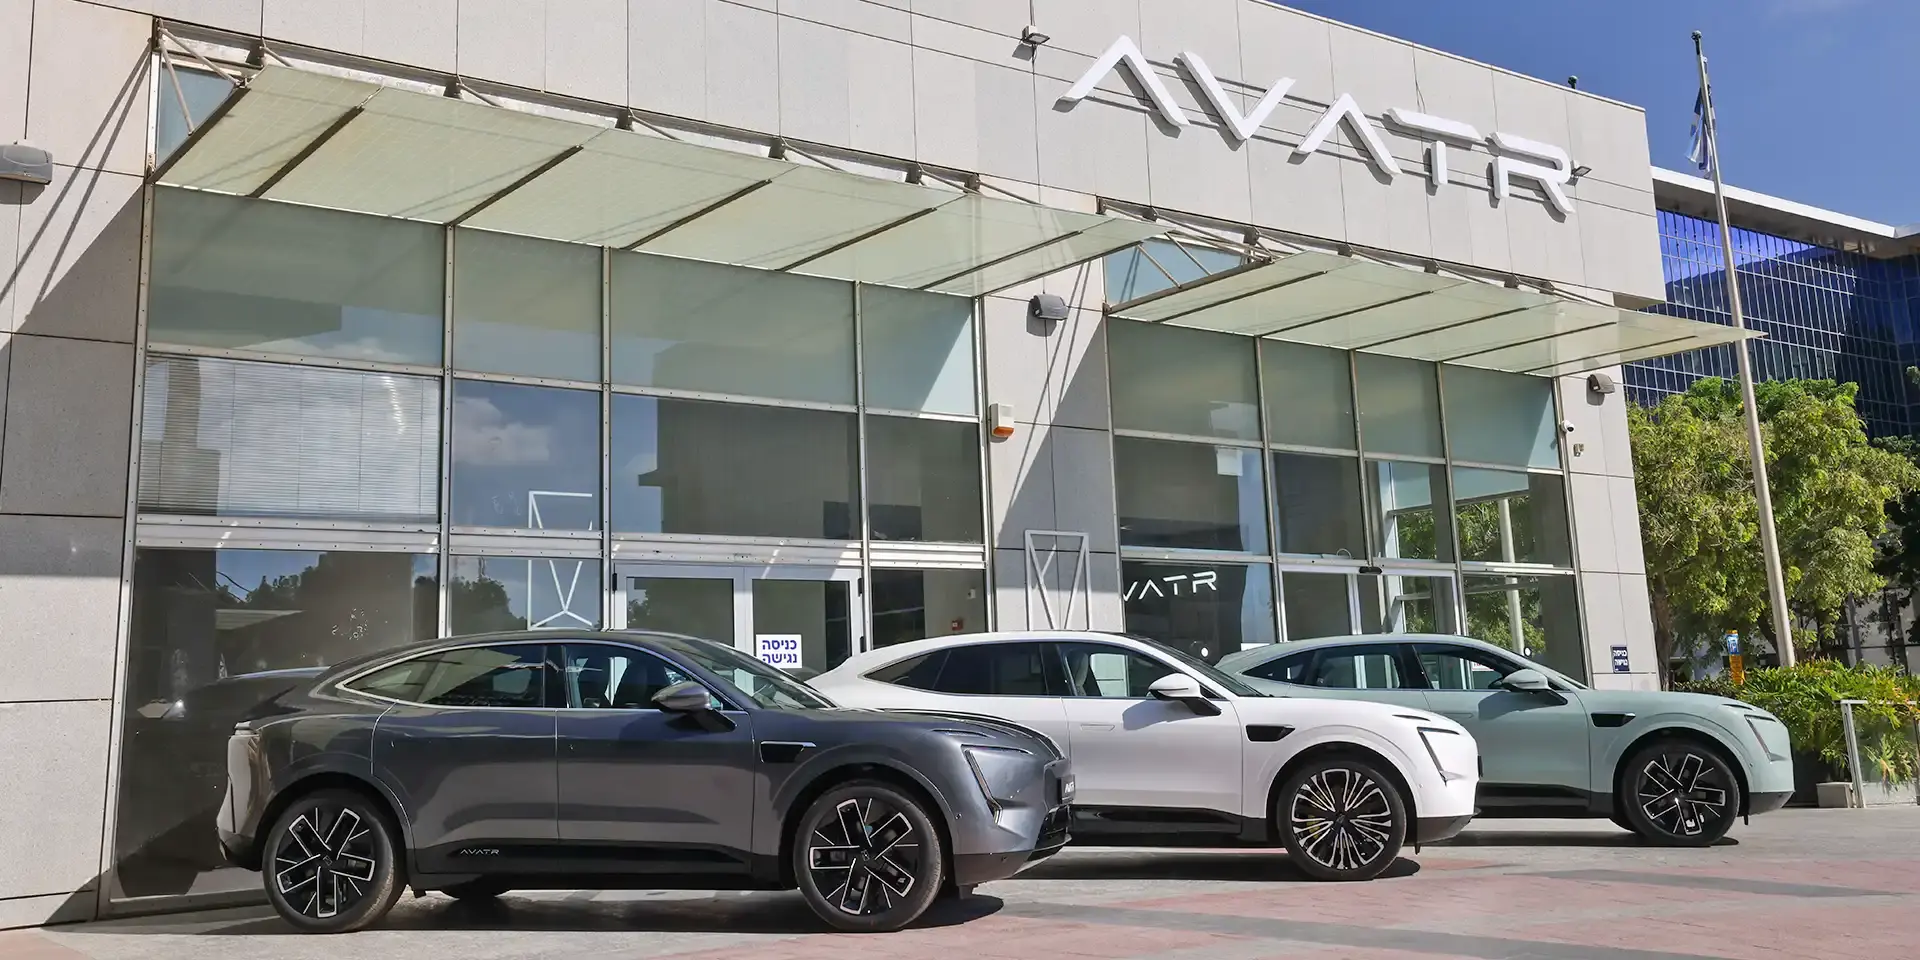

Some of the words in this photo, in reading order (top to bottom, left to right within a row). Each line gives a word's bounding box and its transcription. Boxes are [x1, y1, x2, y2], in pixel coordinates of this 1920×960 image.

[1057, 34, 1576, 216] AVATR
[762, 639, 798, 650] כניסה
[762, 653, 798, 664] נגישה
[460, 848, 500, 856] AVATR
